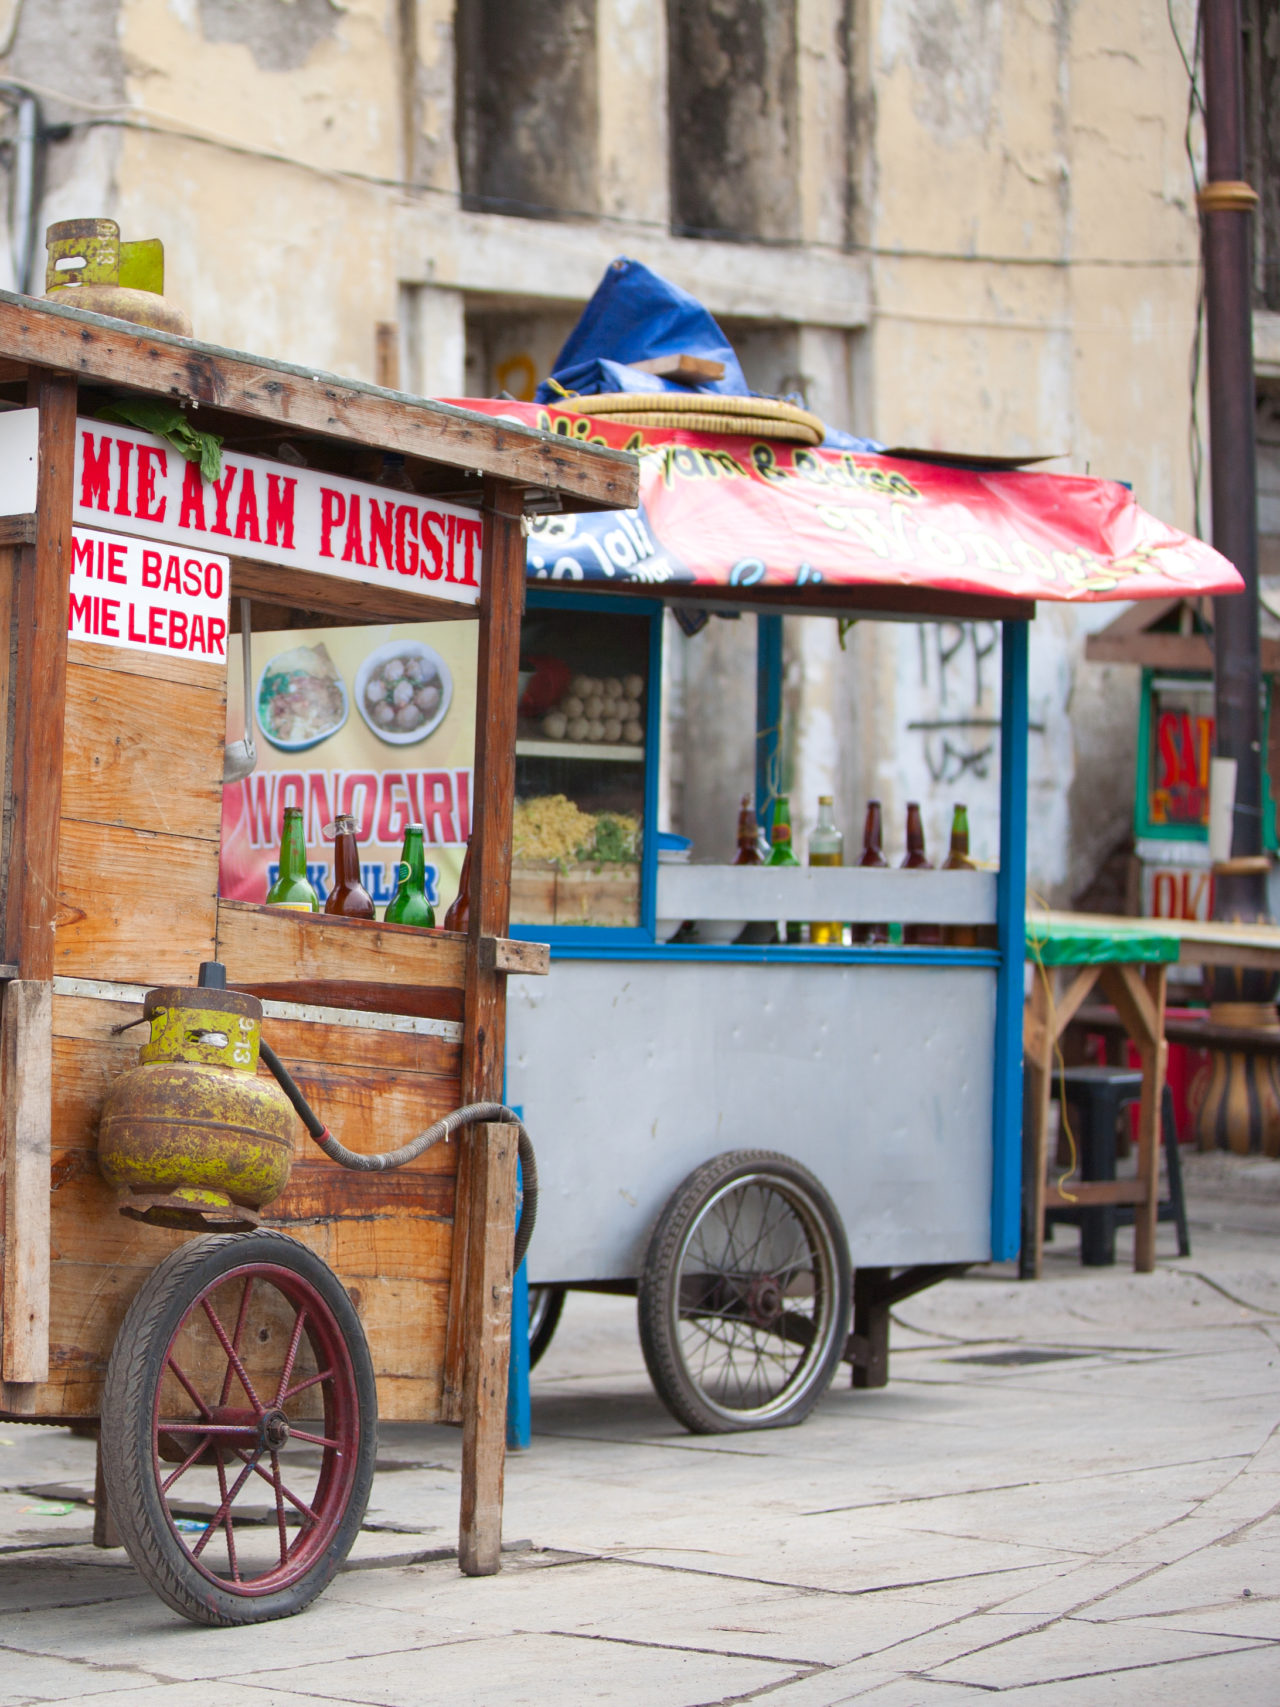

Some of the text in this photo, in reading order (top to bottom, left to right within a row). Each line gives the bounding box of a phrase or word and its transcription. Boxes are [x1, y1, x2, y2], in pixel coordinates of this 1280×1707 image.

[79, 431, 482, 587] MIE AYAM PANGSIT
[71, 536, 223, 599] MIE BASO
[68, 592, 226, 656] MIE LEBAR
[244, 771, 472, 844] WONOGIRI
